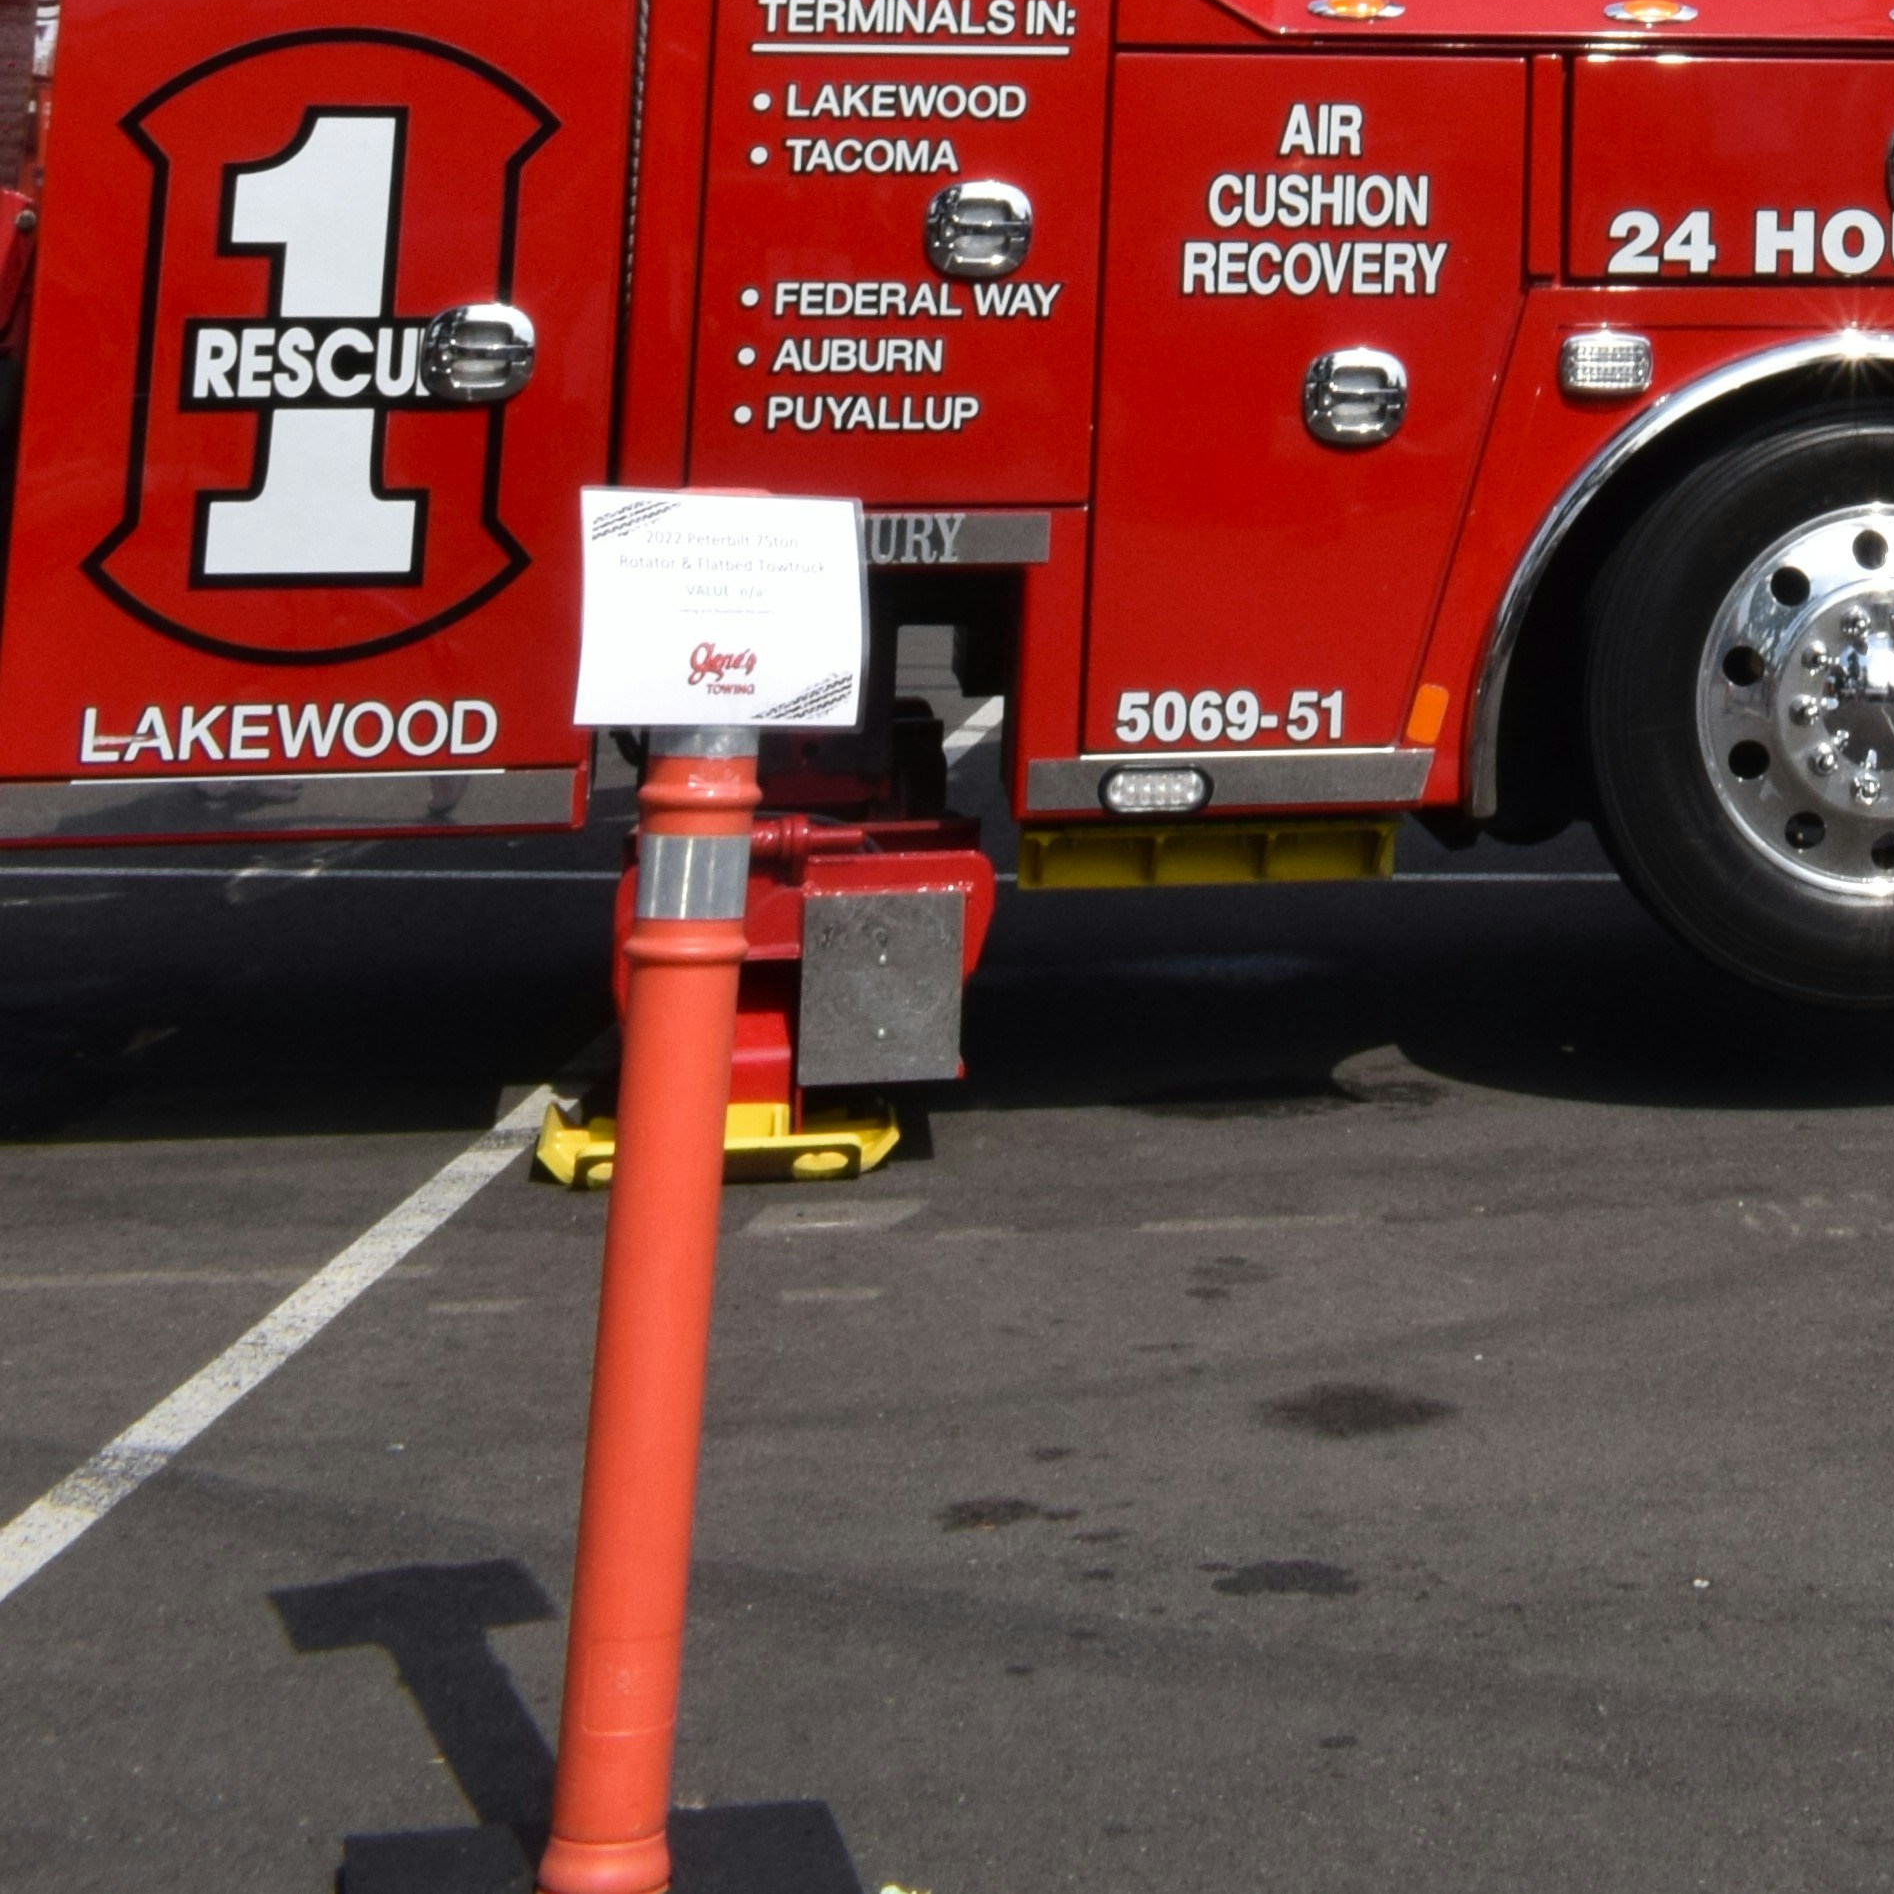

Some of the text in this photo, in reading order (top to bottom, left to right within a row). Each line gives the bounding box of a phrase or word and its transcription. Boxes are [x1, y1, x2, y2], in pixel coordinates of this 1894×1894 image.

[1024, 0, 1077, 36] IN:
[786, 82, 1028, 119] LAKEWOOD
[1278, 103, 1364, 157] AIR
[784, 138, 960, 174] TACOMA
[1207, 173, 1430, 228] CUSHION
[1606, 209, 1718, 275] 24
[1182, 240, 1449, 296] RECOVERY
[774, 281, 1062, 317] FEDERAL WAY
[771, 337, 944, 373] AUBURN
[766, 394, 980, 431] PUYALLUP
[646, 530, 682, 546] 2022
[618, 553, 676, 570] Rotator
[706, 683, 756, 696] TOWING
[79, 700, 499, 764] LAKEWOOD
